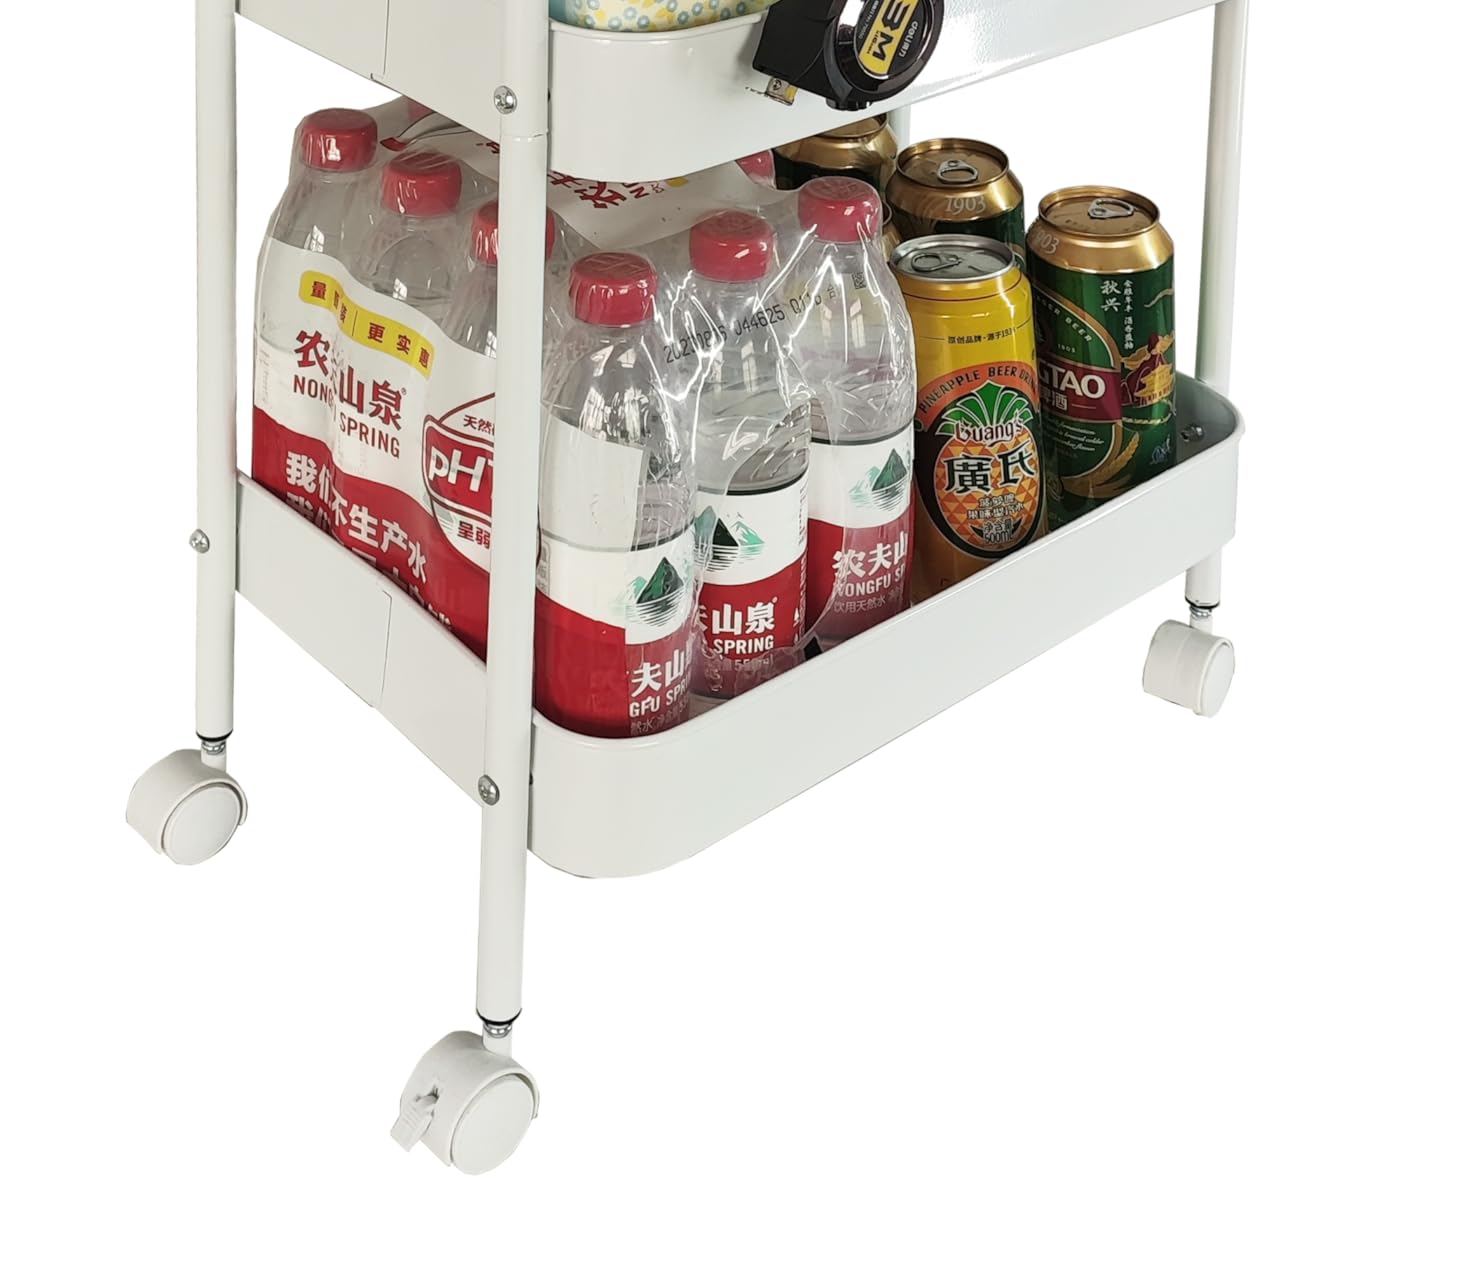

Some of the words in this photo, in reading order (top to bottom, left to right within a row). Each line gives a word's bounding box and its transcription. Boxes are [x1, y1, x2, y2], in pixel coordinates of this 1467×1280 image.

[943, 194, 986, 215] 1903
[1036, 230, 1060, 255] 903
[367, 321, 431, 369] 更实惠
[1064, 316, 1093, 342] BEER
[919, 369, 981, 414] PINEAPPLE
[988, 365, 1018, 378] BEER
[339, 411, 401, 459] SPRING
[463, 414, 495, 436] 天然
[428, 445, 494, 493] pH
[943, 439, 1035, 494] 廣氏
[286, 450, 428, 584] 我们不生产水
[713, 635, 775, 655] SPRING
[629, 695, 661, 718] GFU
